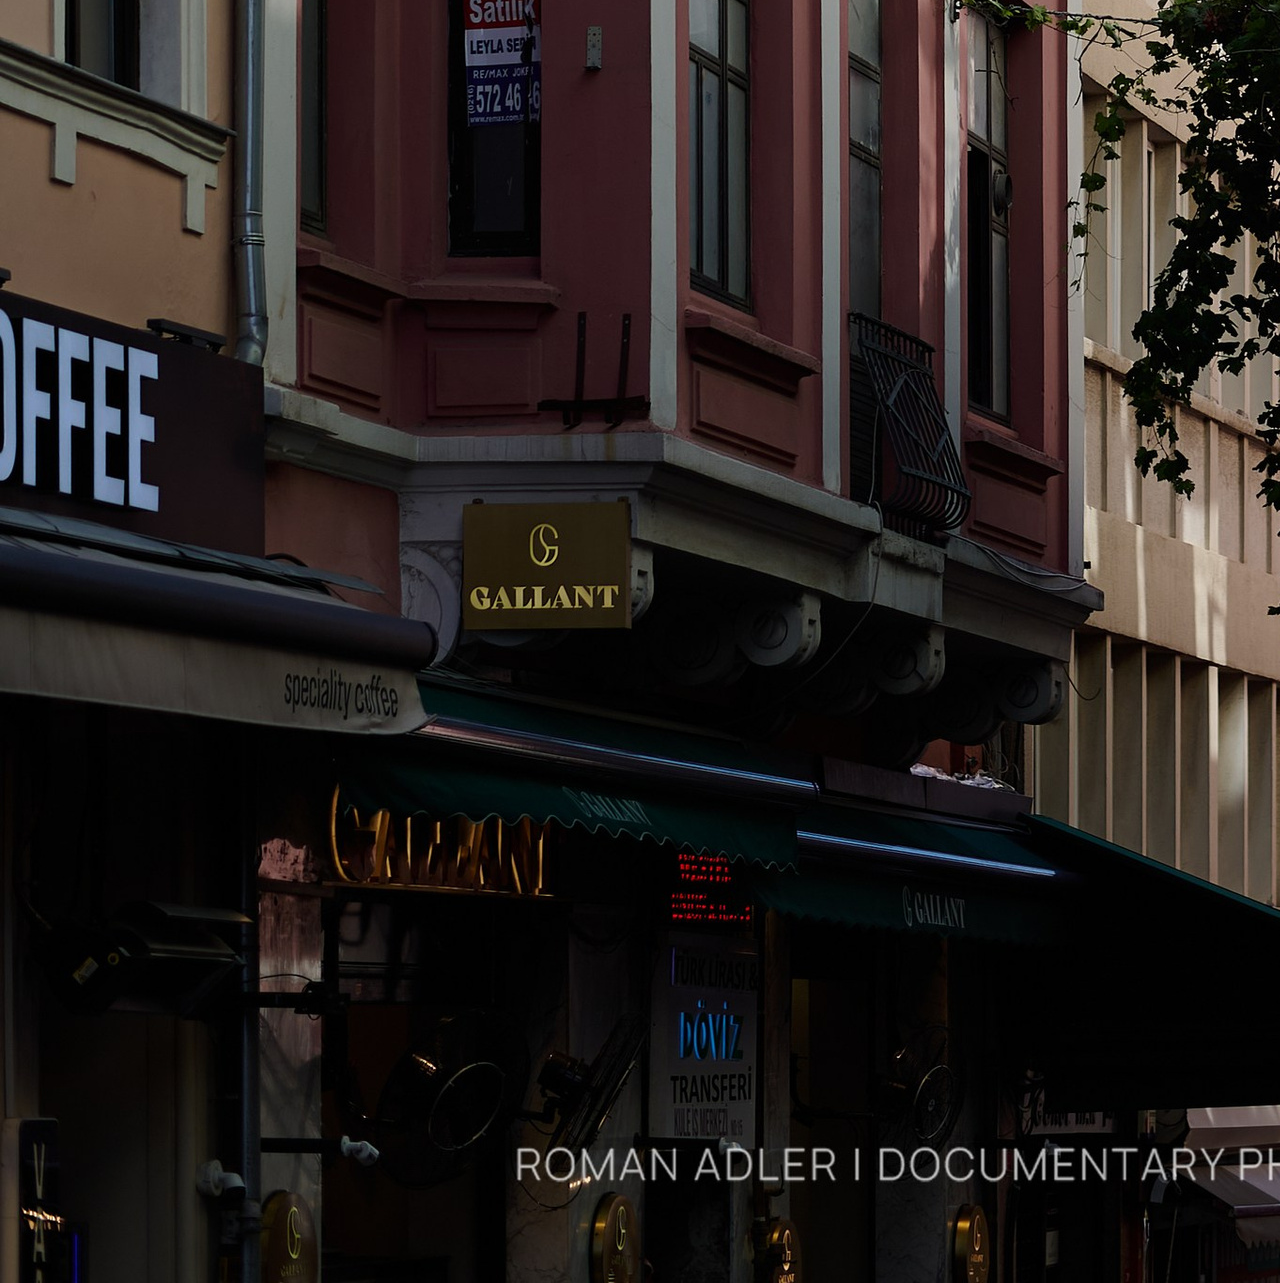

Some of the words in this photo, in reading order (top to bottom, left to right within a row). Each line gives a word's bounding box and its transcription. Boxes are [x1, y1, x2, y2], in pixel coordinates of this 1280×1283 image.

[470, 39, 504, 55] LEYLA
[473, 68, 509, 80] RE/MAX
[476, 84, 502, 114] 572
[505, 82, 522, 112] 46
[469, 585, 620, 610] GALLANT
[284, 667, 352, 721] speciality
[355, 674, 399, 717] coffee
[580, 791, 654, 827] GALLANT
[914, 891, 966, 930] GALLANT
[679, 998, 745, 1062] DÖVİZ
[670, 1066, 752, 1105] TRANSFERİ
